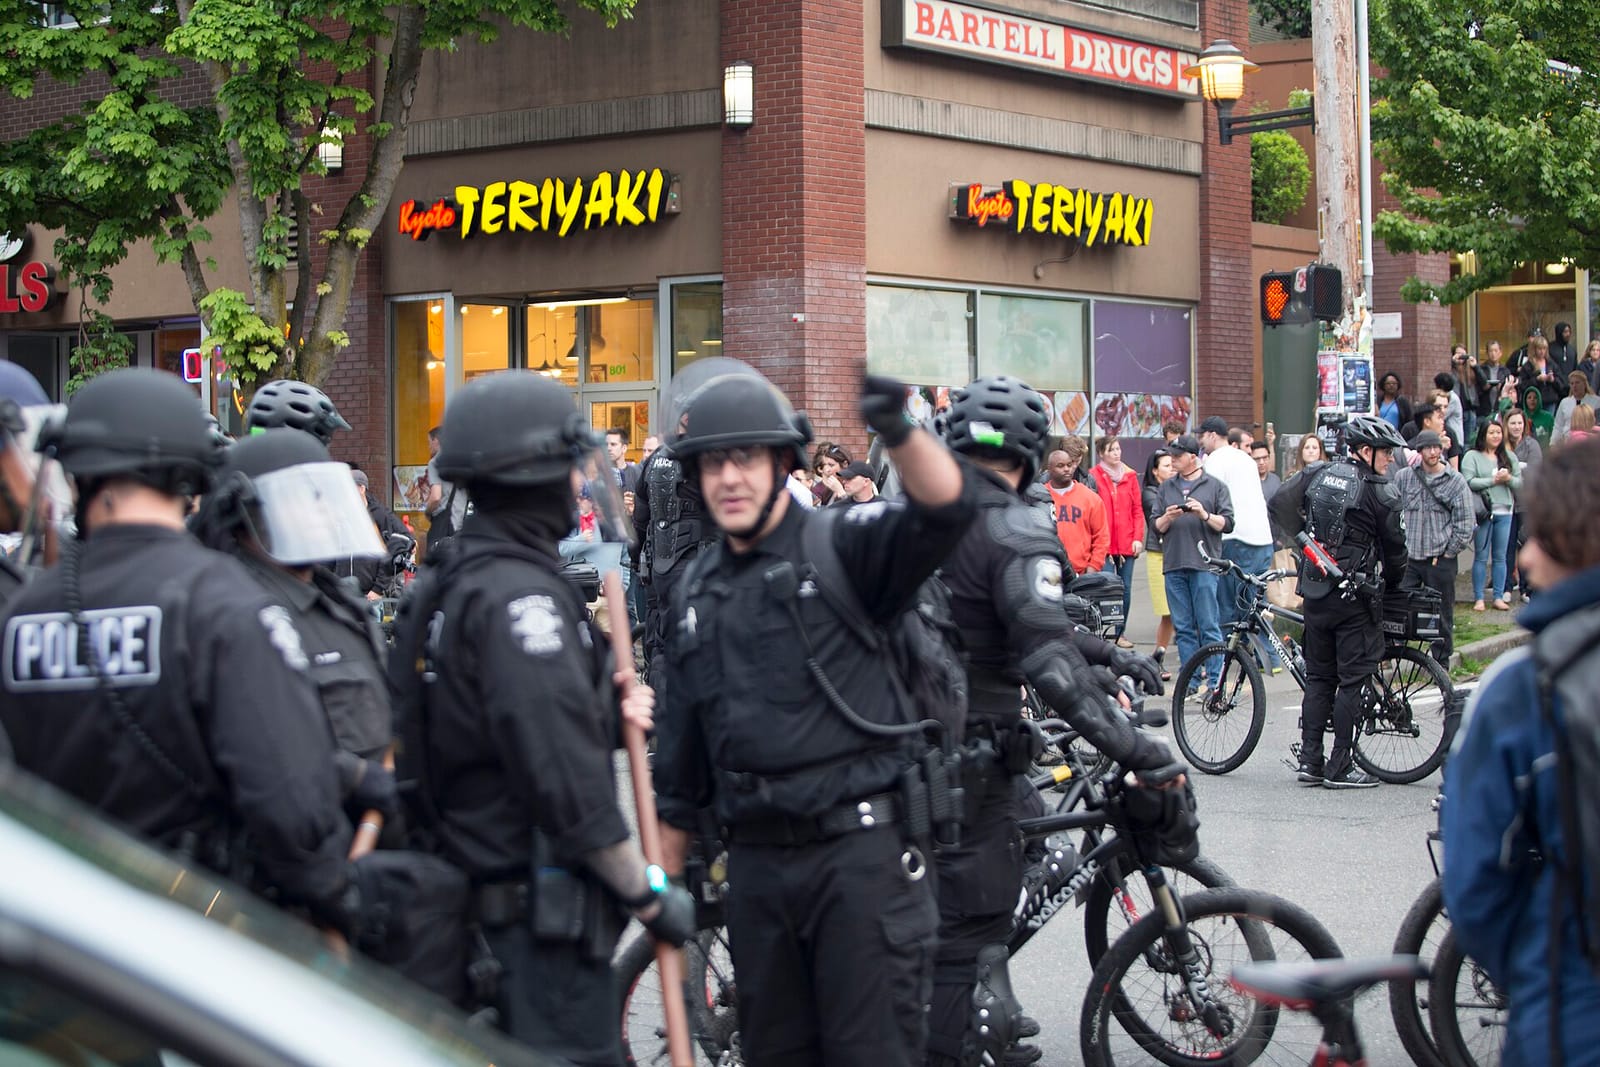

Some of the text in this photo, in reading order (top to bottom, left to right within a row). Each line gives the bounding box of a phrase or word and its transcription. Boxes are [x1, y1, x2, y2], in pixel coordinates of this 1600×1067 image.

[914, 0, 1174, 86] BARTELL DRUGS
[399, 168, 664, 241] Kyoto TERIYAKI
[967, 179, 1154, 247] Kyoto TERIYAKI
[609, 364, 626, 376] 801
[1322, 475, 1348, 490] POLICE
[1056, 505, 1083, 524] AP
[1383, 622, 1404, 633] OLICE
[1268, 633, 1295, 670] volcanic
[1027, 859, 1100, 928] volcanic
